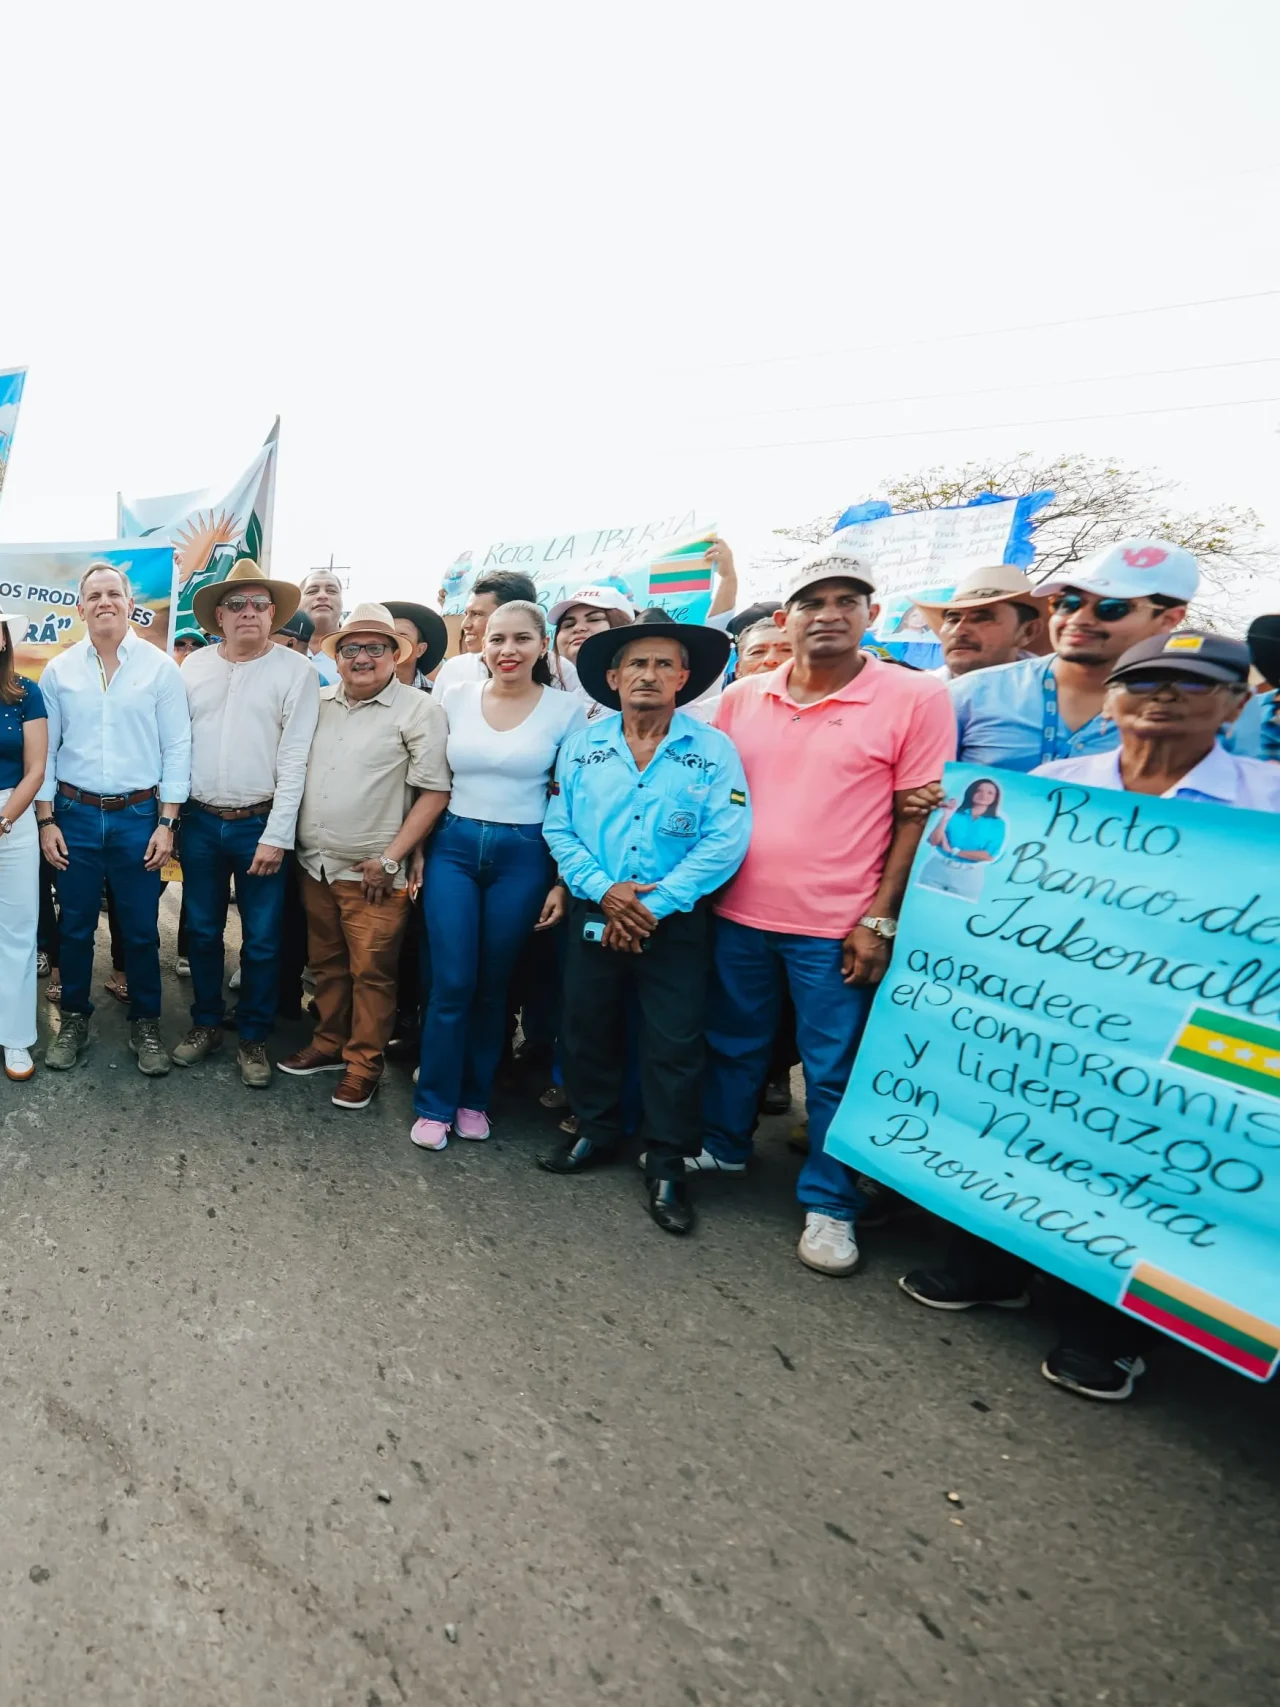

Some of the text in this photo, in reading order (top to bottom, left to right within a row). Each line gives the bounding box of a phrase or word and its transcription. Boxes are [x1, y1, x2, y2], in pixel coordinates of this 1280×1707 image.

[543, 533, 575, 562] LA
[27, 586, 153, 626] PRODES
[1004, 841, 1280, 946] Banco de
[904, 1034, 931, 1070] y
[872, 1069, 941, 1118] con
[870, 1113, 1136, 1272] Provincia
